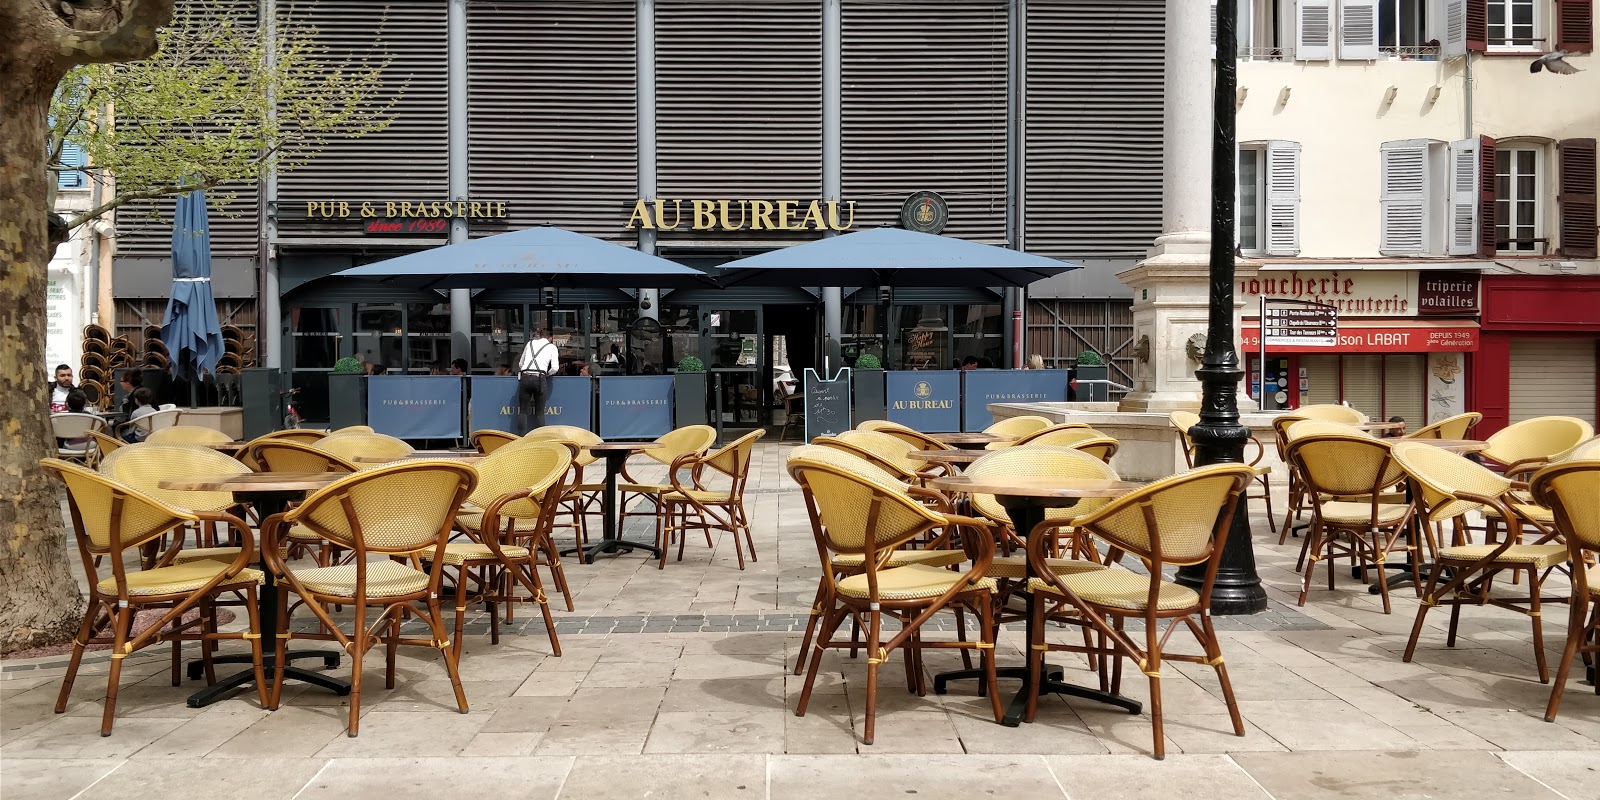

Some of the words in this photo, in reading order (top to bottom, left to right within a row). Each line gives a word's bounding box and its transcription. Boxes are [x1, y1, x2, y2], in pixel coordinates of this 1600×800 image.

[307, 201, 351, 217] PUB
[360, 201, 376, 217] &
[385, 201, 507, 218] BRASSERIE
[625, 199, 682, 230] AU
[691, 200, 856, 230] BUREAU
[367, 219, 403, 232] since
[408, 219, 447, 232] 1989
[1426, 280, 1473, 293] triperie
[1421, 295, 1473, 307] volailles
[1337, 334, 1363, 346] ison
[1367, 333, 1410, 346] LABAT
[500, 406, 515, 415] AU
[892, 401, 907, 410] AU
[909, 400, 954, 410] BUREAU
